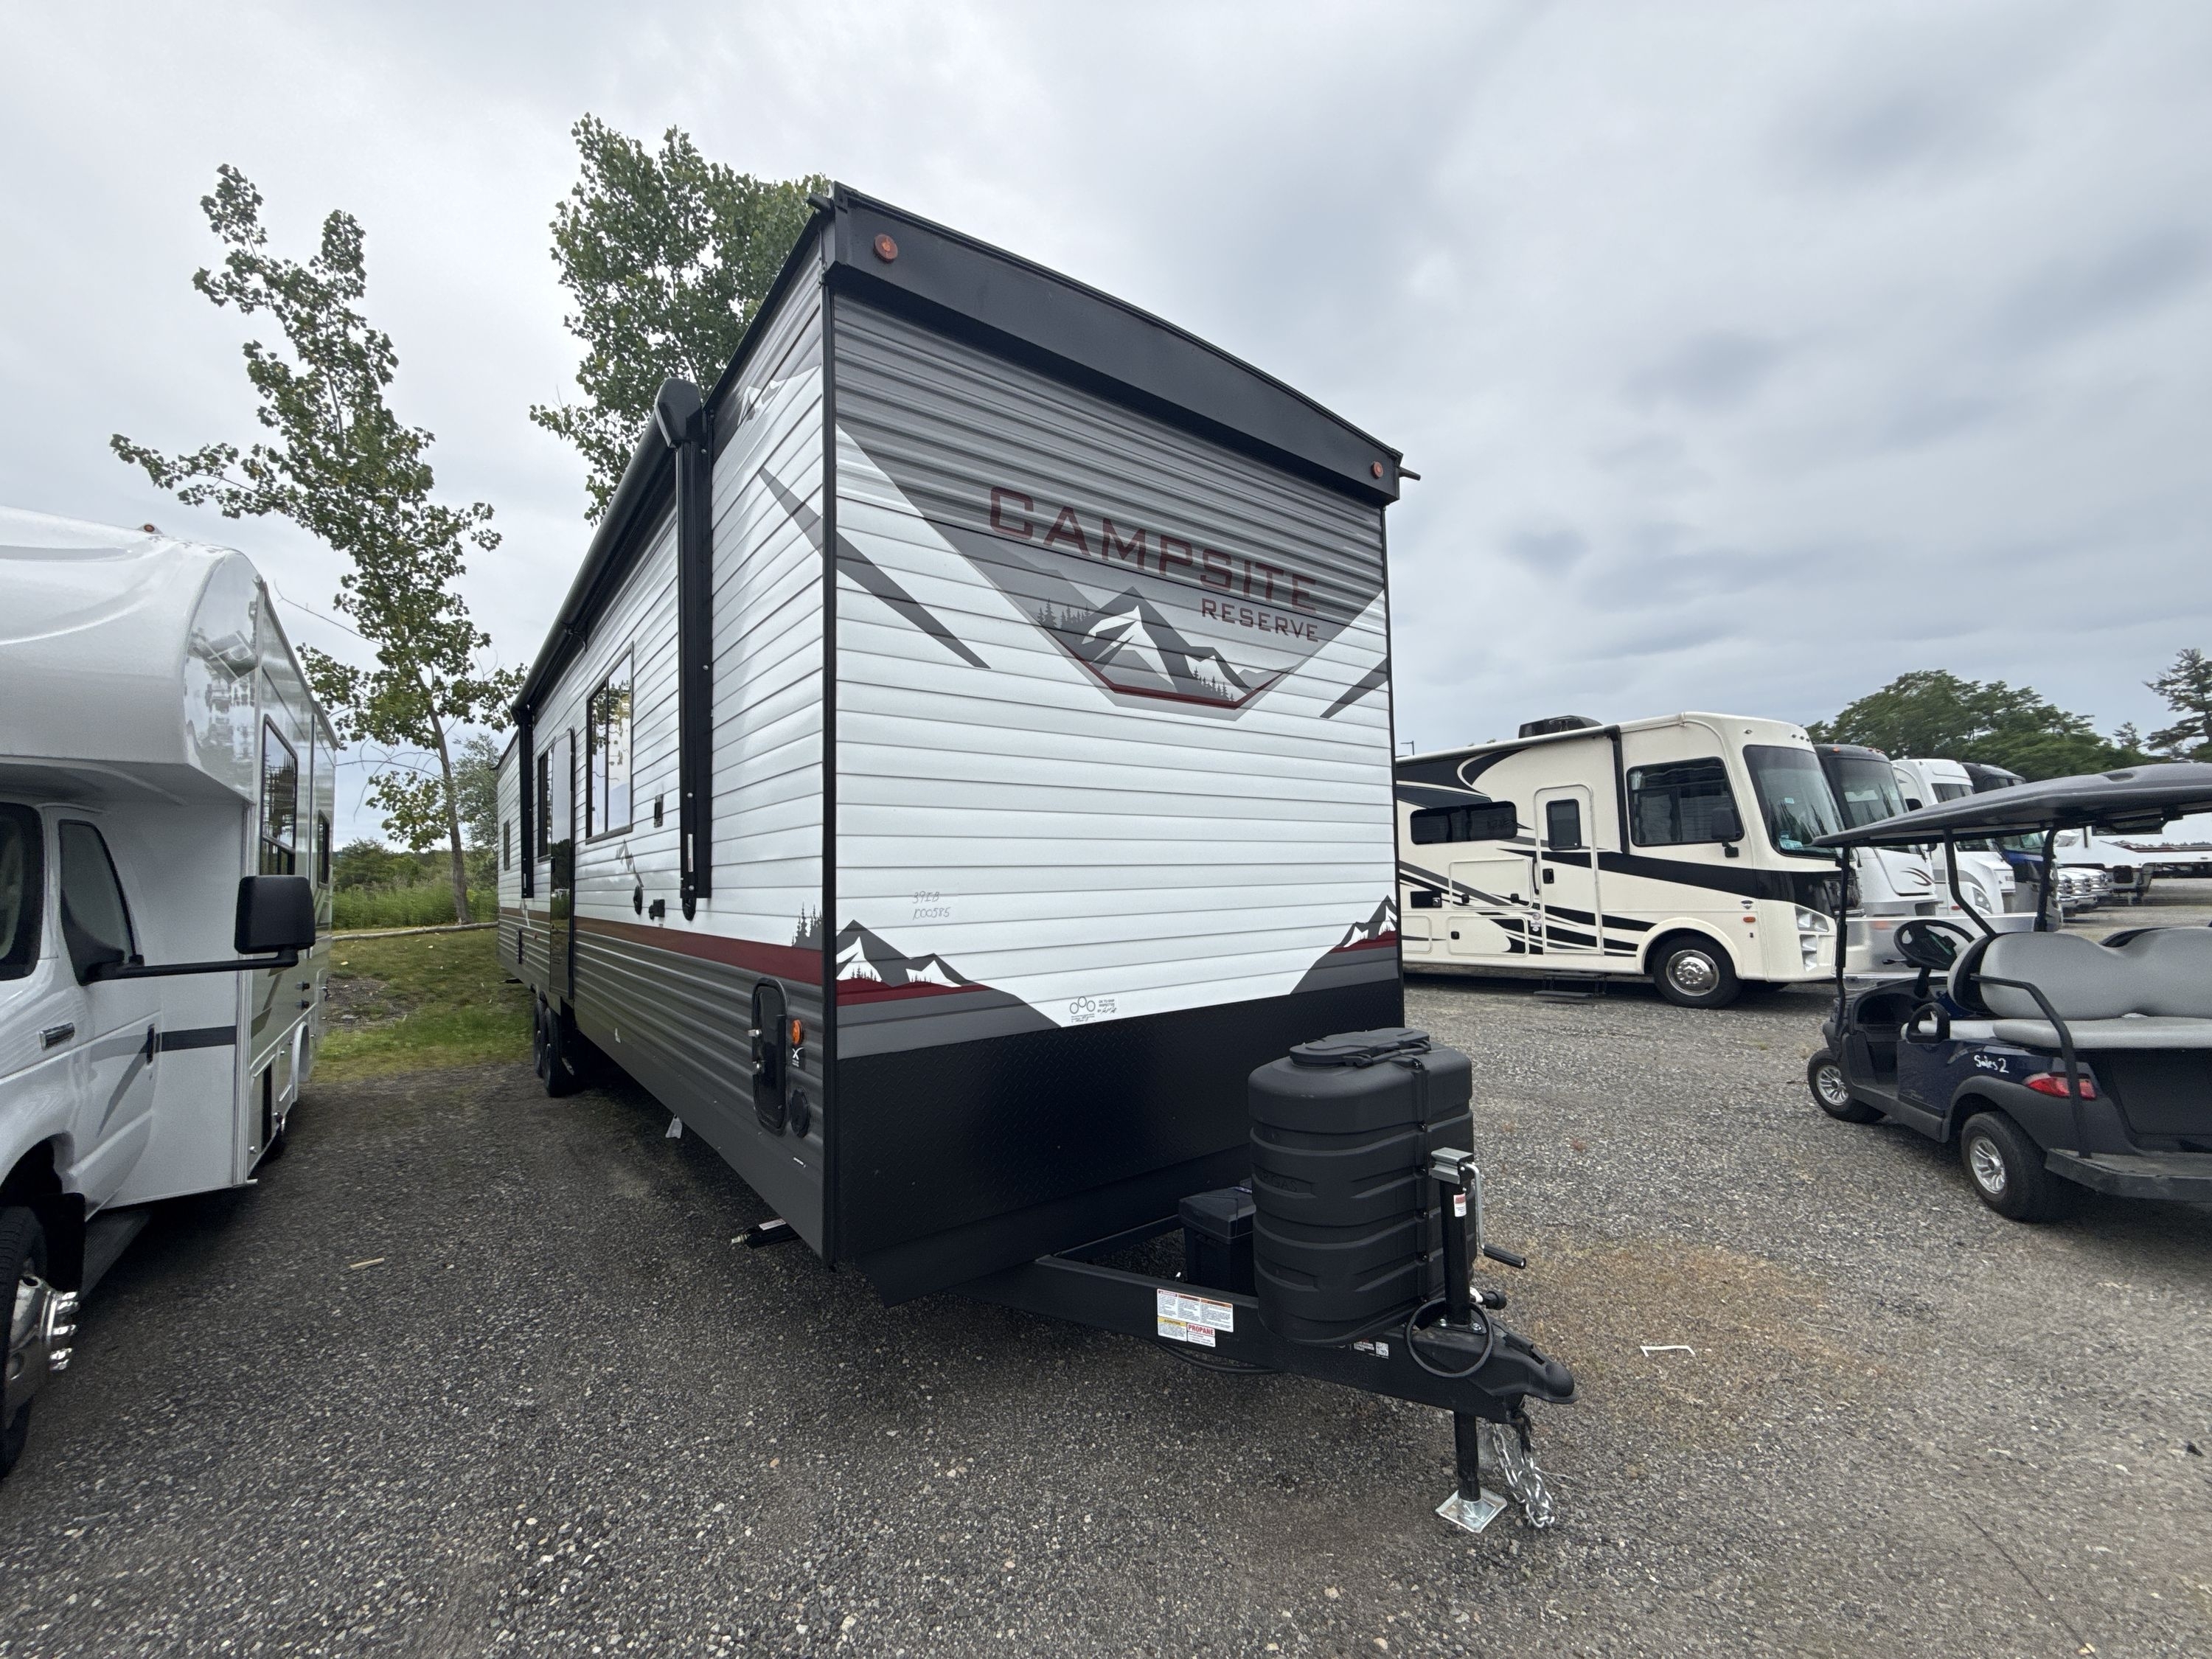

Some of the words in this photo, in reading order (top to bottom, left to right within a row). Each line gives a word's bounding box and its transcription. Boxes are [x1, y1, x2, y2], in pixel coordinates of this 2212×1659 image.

[990, 486, 1317, 614] CAMPSITE
[1201, 598, 1319, 642] RESERVE
[1974, 1054, 1997, 1070] Sales
[1998, 1057, 2009, 1074] 2
[1272, 1175, 1298, 1192] GAS
[1188, 1324, 1214, 1335] PROPANE
